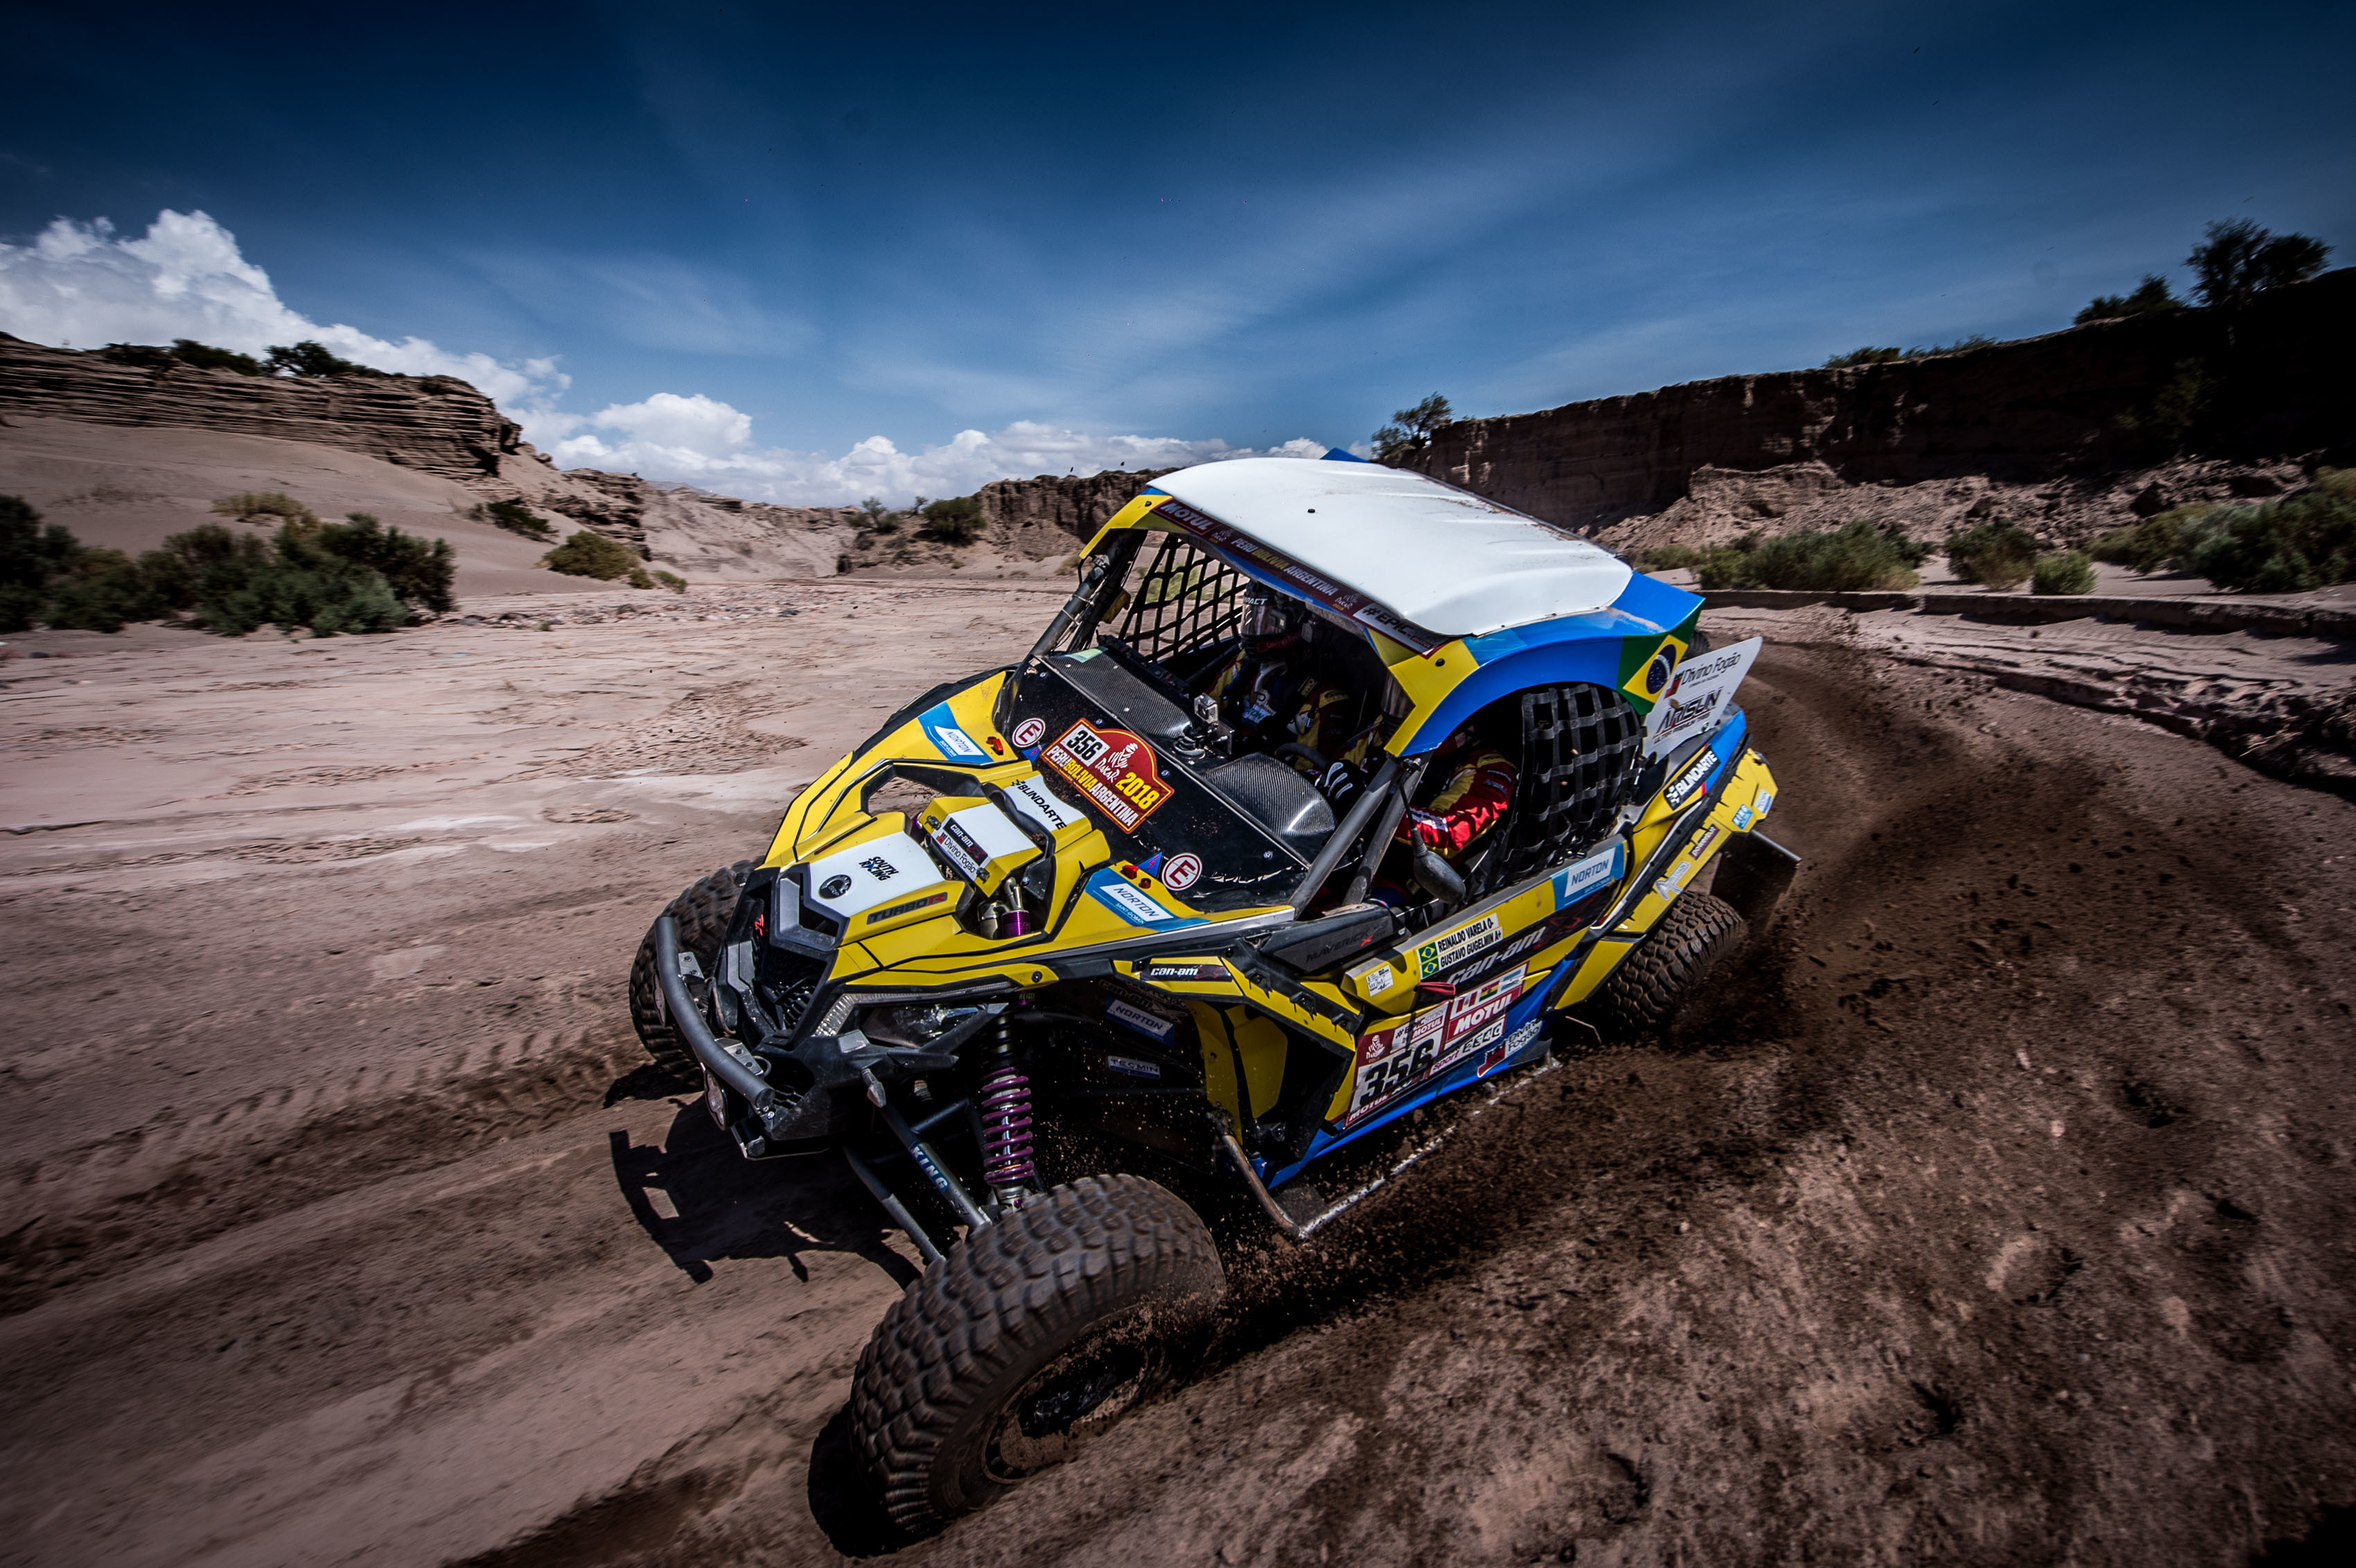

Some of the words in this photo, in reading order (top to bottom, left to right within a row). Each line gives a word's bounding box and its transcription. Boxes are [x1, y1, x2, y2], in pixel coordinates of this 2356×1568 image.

[1160, 502, 1213, 531] MOTUL
[1231, 538, 1258, 553] PERU
[1251, 548, 1290, 570] BOLIVIA
[1283, 565, 1339, 597] ARGENTINA
[1681, 664, 1712, 686] Divino
[1713, 652, 1741, 674] Fogão
[944, 731, 973, 753] NORTON
[1019, 722, 1040, 743] E
[1066, 730, 1103, 761] 356
[1095, 757, 1120, 784] DAKAR
[1676, 750, 1718, 796] BLINDARTE
[1046, 745, 1072, 767] PERU
[1063, 759, 1099, 791] BOLIVIA
[1089, 782, 1139, 827] ARGENTINA
[1115, 771, 1160, 810] 2018
[1017, 784, 1067, 830] BLINDARTE
[950, 825, 974, 847] can-am
[868, 856, 899, 875] SOUTH
[944, 837, 961, 857] Divino
[960, 853, 976, 873] Fogão
[1169, 860, 1196, 886] E
[1571, 859, 1609, 886] NORTON
[828, 886, 840, 896] BRP
[1114, 888, 1159, 917] NORTON
[1115, 903, 1144, 924] SAINT-GOBAIN
[1438, 933, 1467, 953] REINALDO
[1466, 922, 1488, 940] VARELA
[1441, 947, 1467, 968] GUSTAVO
[1467, 935, 1495, 955] GUGELMIN
[1494, 931, 1502, 942] A+
[1447, 926, 1546, 985] can-am
[1151, 967, 1199, 977] can-am
[1116, 1006, 1163, 1030] NORTON
[1412, 1018, 1441, 1039] MOTUL
[1453, 994, 1513, 1036] MOTUL
[1509, 1027, 1540, 1052] Fogão
[1110, 1059, 1160, 1073] TECMIN
[1360, 1038, 1434, 1105] 356
[911, 1145, 949, 1190] KING
